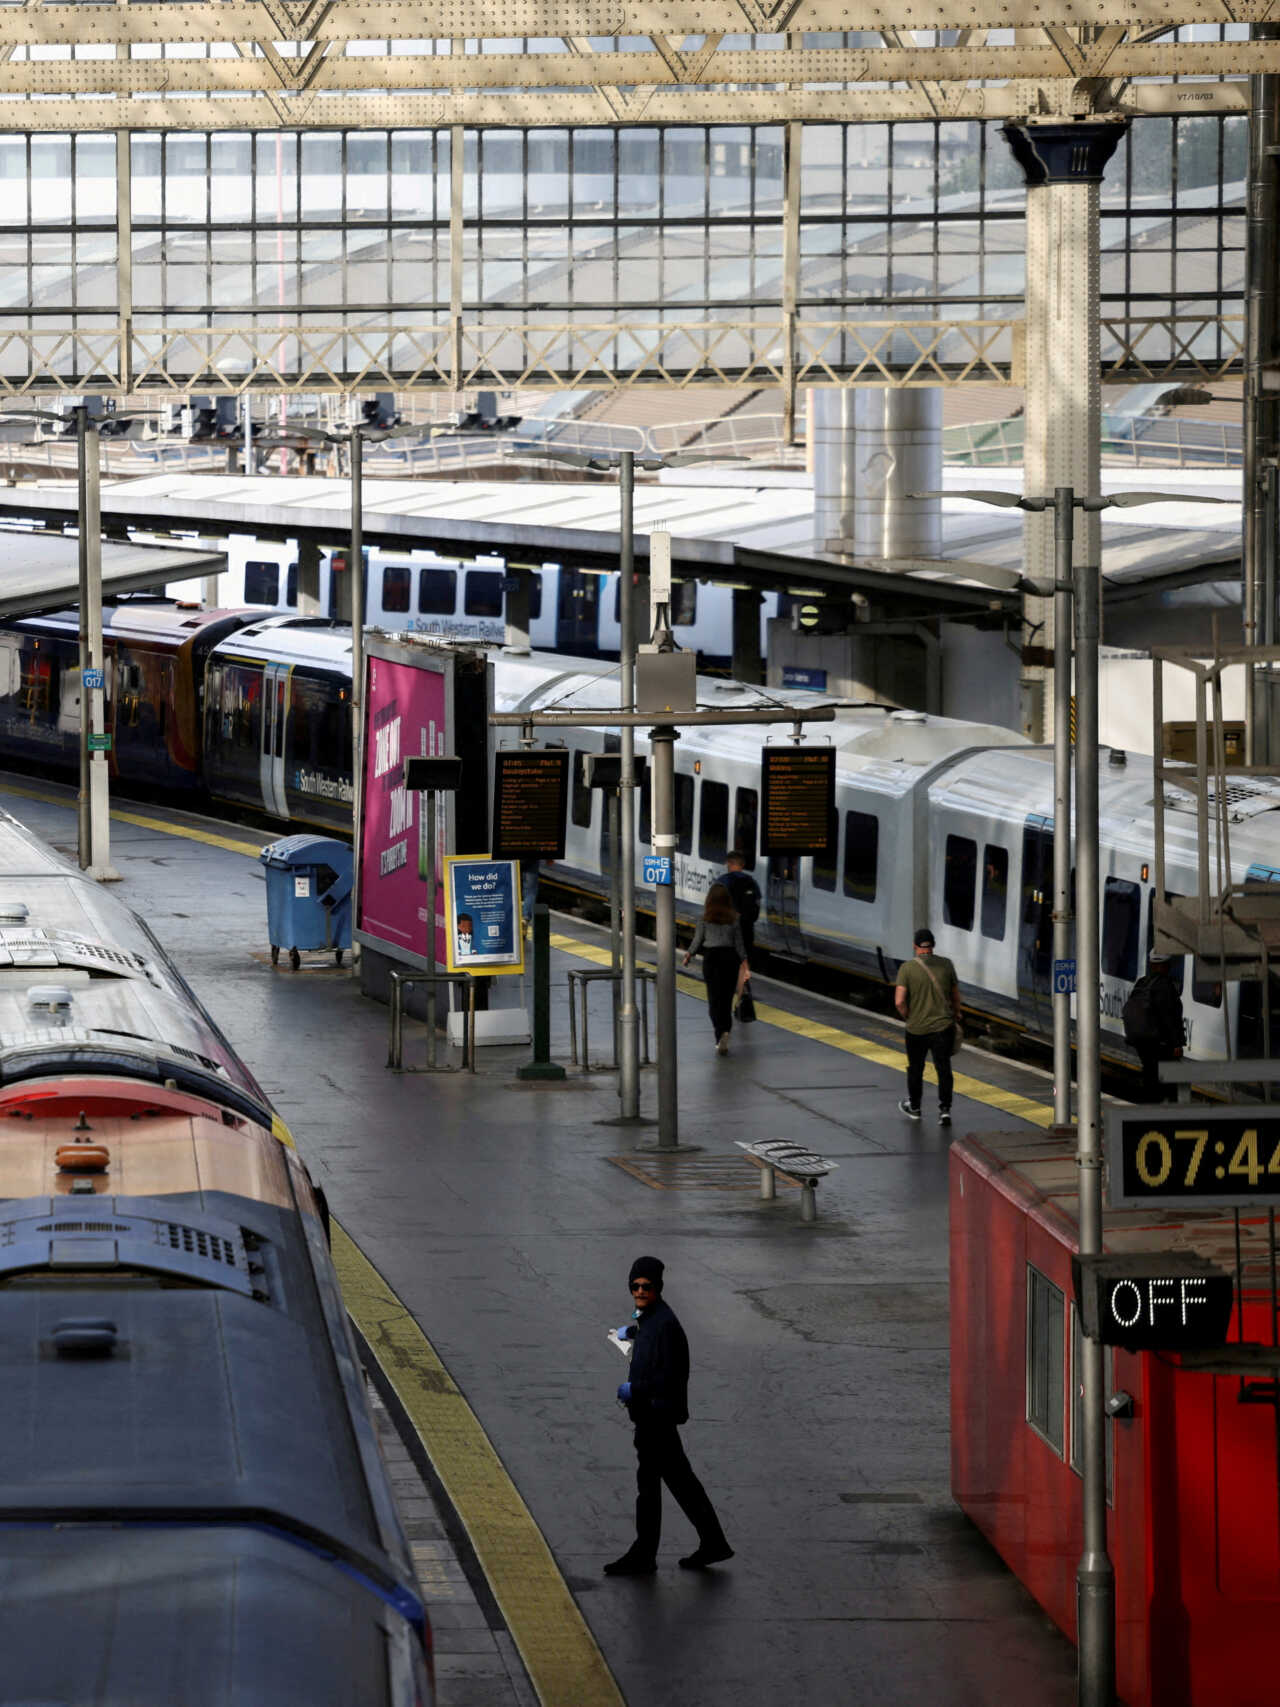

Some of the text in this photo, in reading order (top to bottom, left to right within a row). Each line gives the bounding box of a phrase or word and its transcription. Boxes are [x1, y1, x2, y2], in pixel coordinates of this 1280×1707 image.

[416, 617, 439, 634] South
[440, 616, 478, 639] Western
[86, 677, 101, 687] 017
[468, 872, 498, 881] How did
[646, 868, 666, 883] 017
[1057, 974, 1077, 992] 01
[1111, 1279, 1207, 1327] OFF
